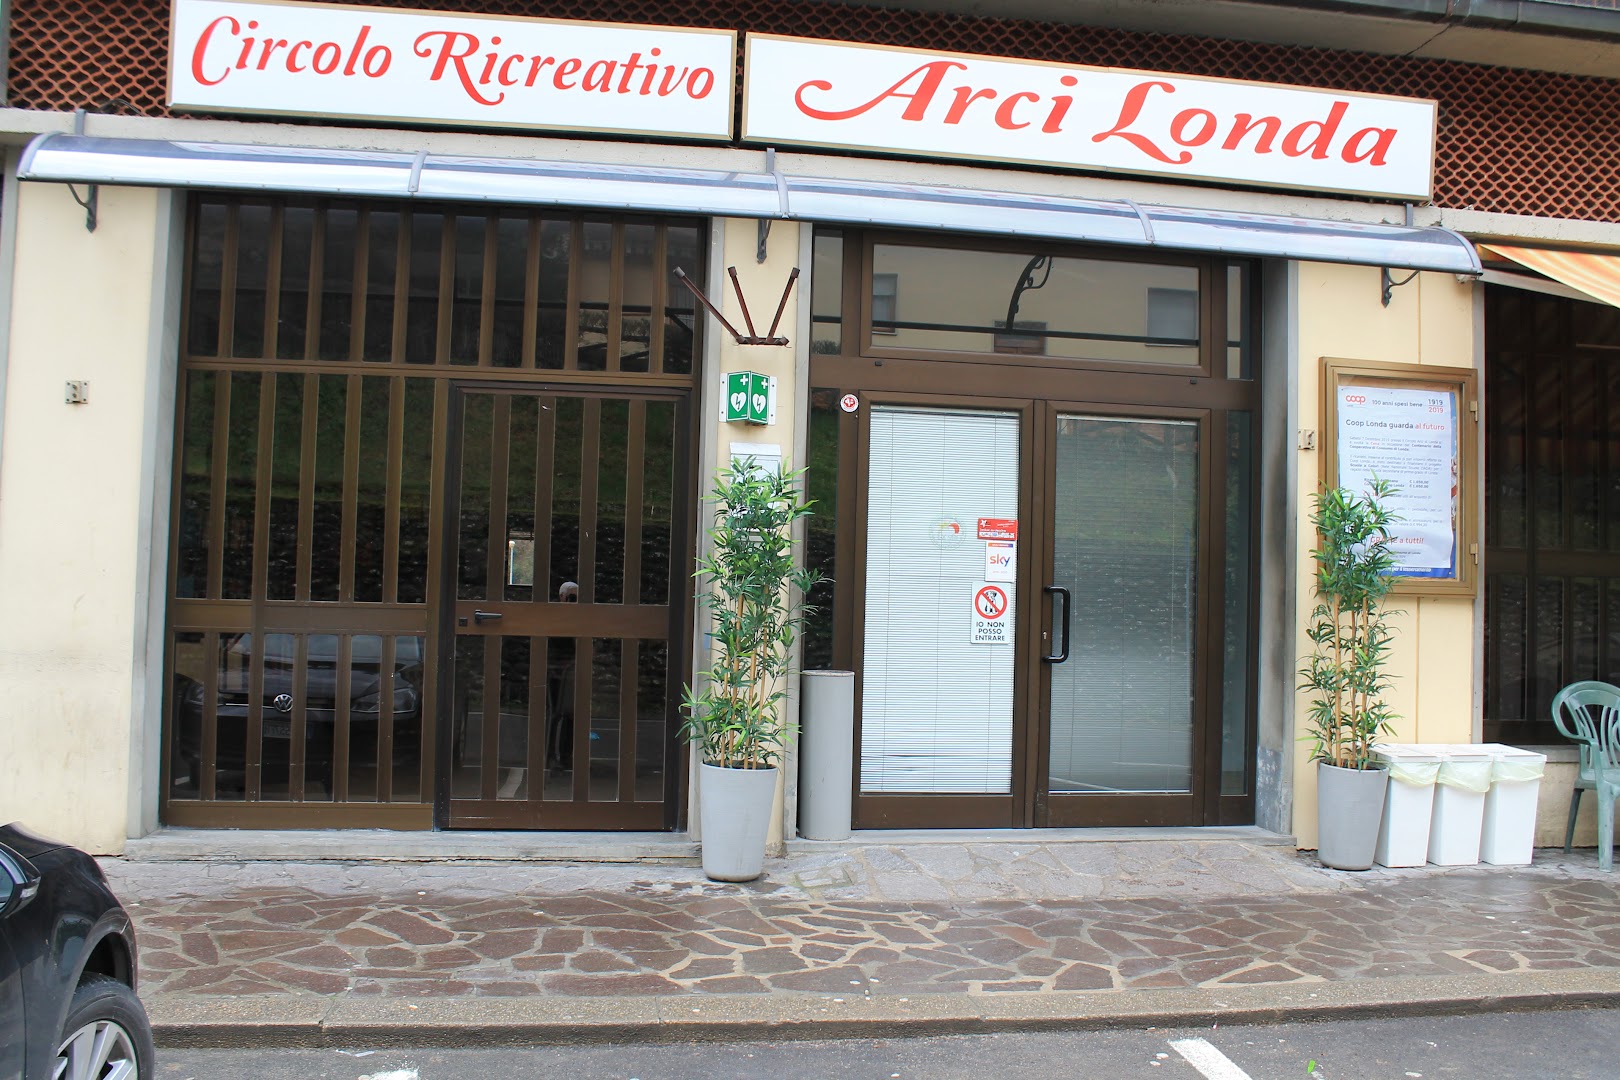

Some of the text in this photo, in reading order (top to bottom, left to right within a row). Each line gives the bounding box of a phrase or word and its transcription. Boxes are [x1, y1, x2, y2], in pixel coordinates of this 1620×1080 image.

[191, 15, 715, 107] Circolo Ricreativo
[794, 60, 1398, 167] Arci Londa
[1346, 395, 1366, 404] coop
[1346, 419, 1364, 427] Coop
[1366, 420, 1387, 428] Londa
[990, 553, 1011, 567] sky
